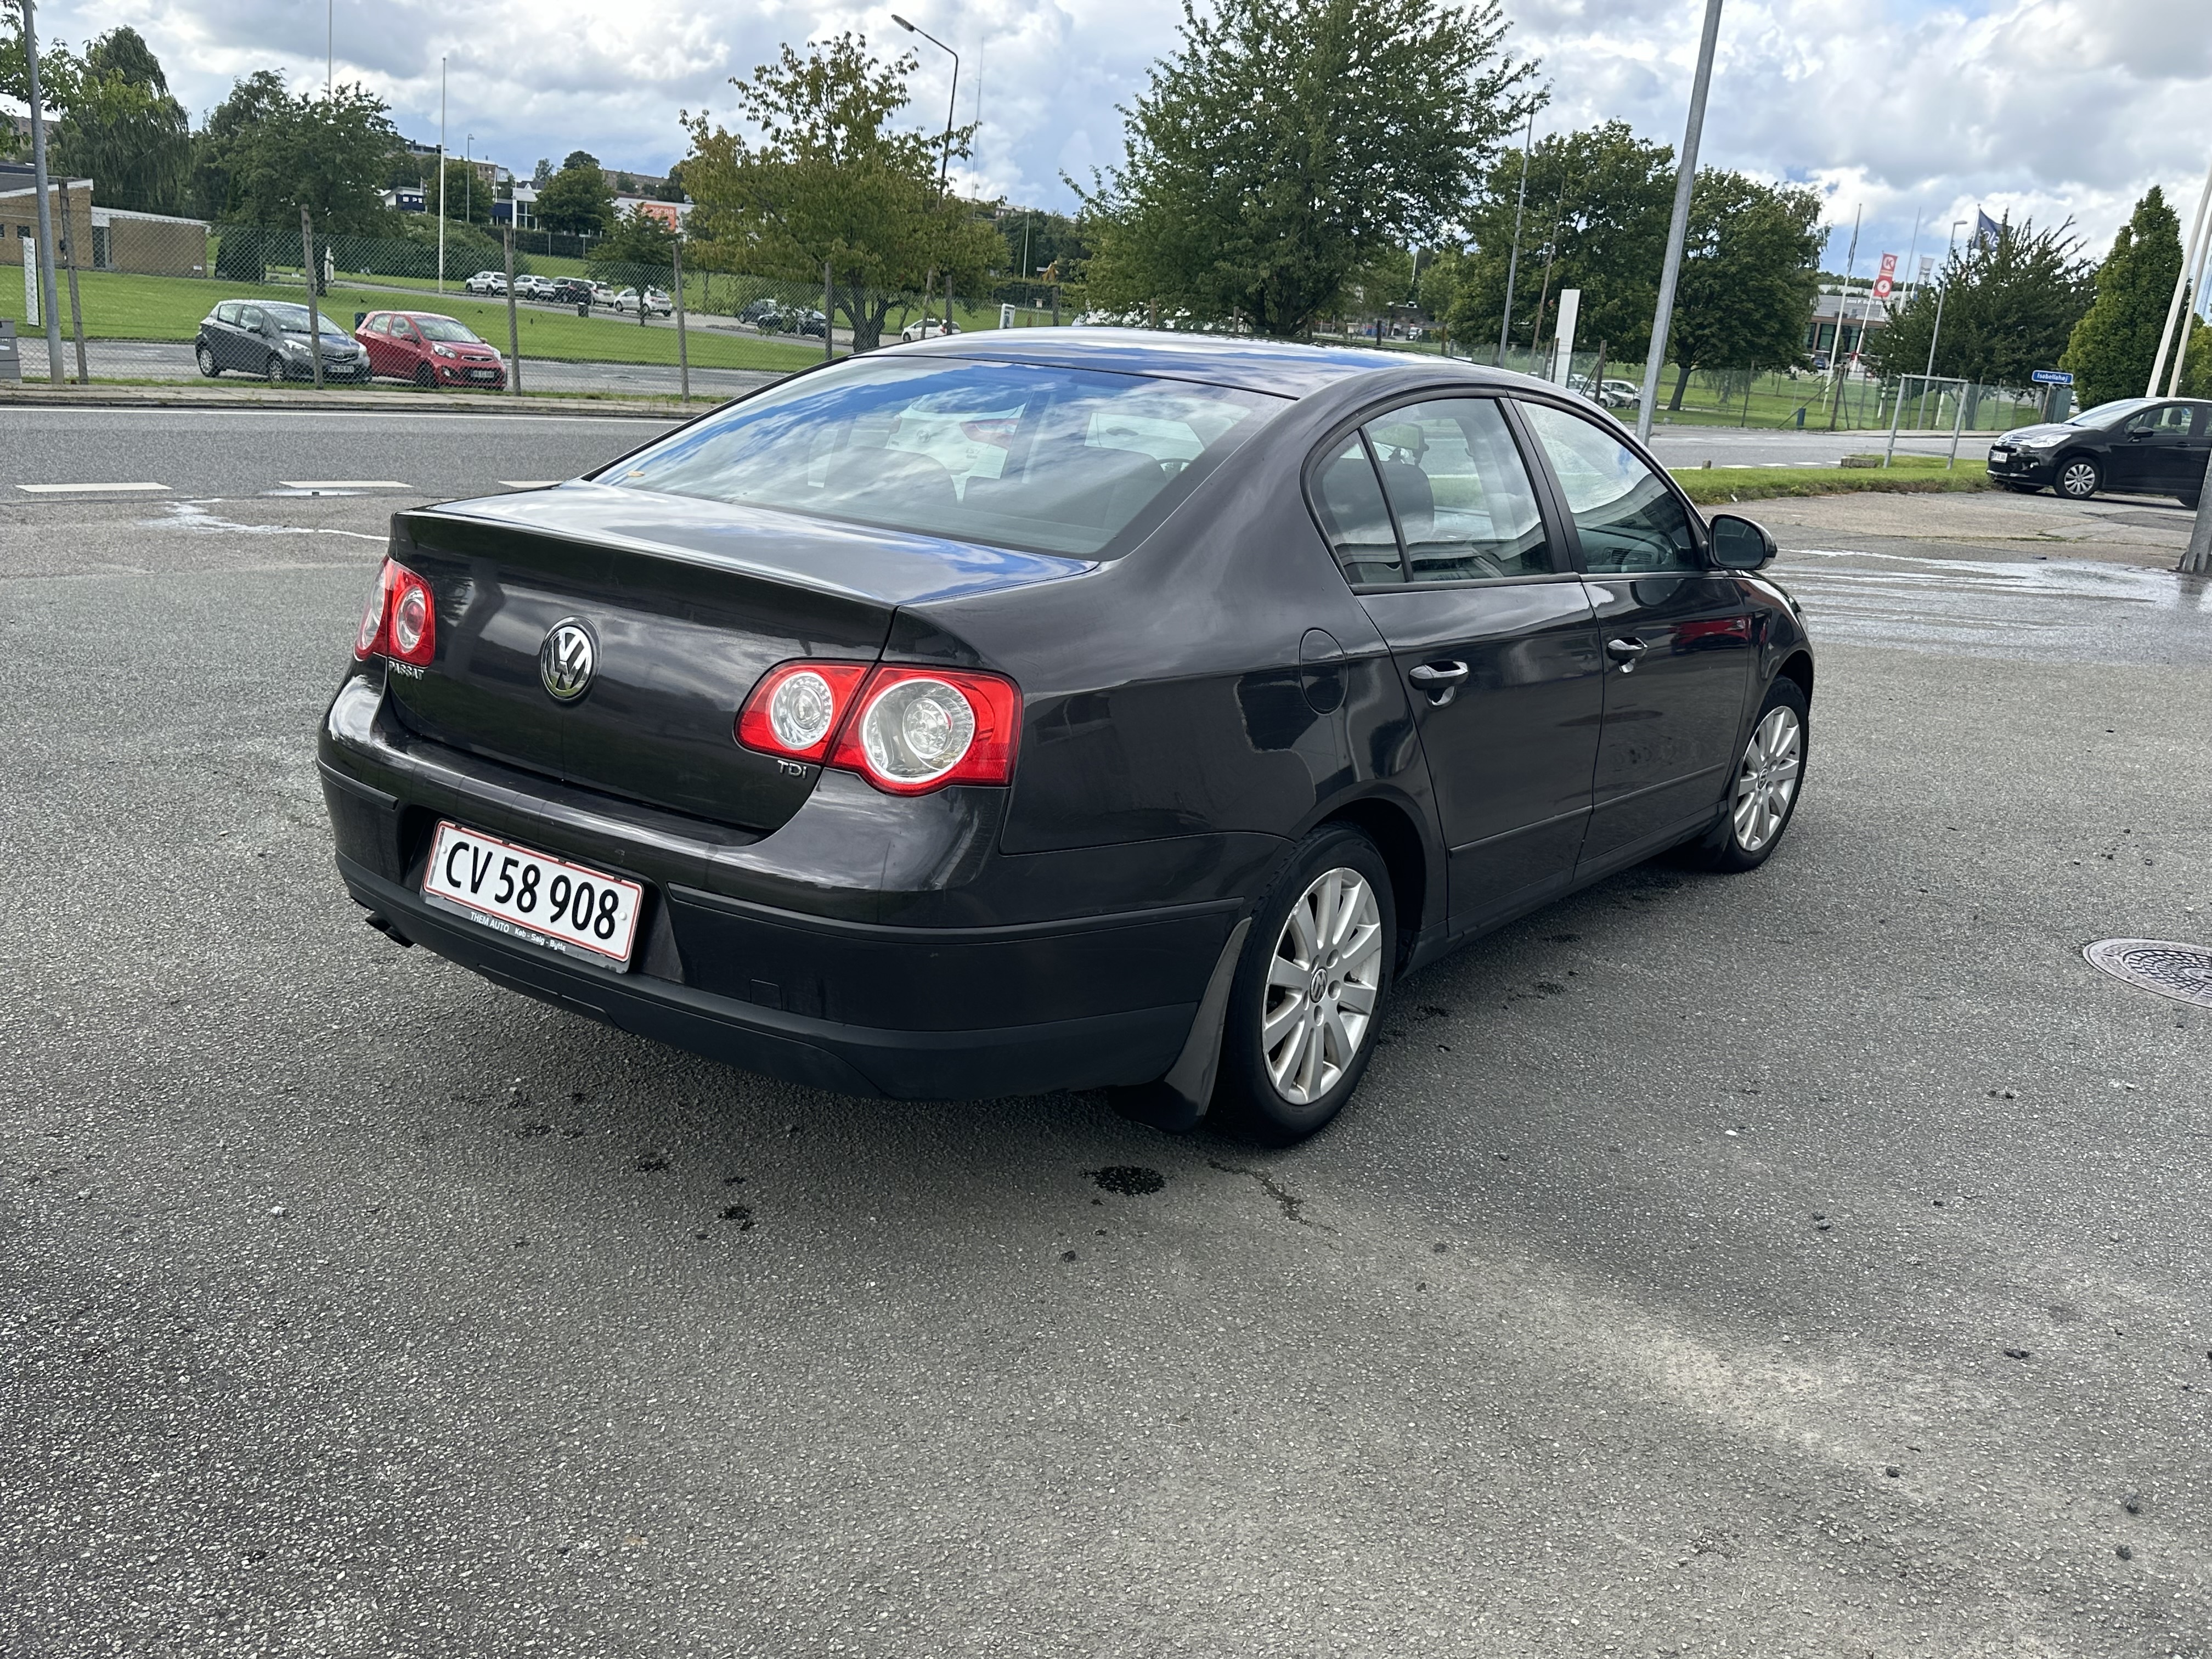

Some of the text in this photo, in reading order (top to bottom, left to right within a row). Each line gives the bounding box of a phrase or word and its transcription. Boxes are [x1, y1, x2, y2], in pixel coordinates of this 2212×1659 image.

[388, 661, 424, 680] PASSAT
[777, 760, 807, 778] TDI
[446, 842, 619, 939] CV 58 908
[471, 911, 489, 926] THEM
[489, 921, 510, 933] AUTO
[531, 934, 545, 945] Salg
[550, 940, 566, 951] Bytte
